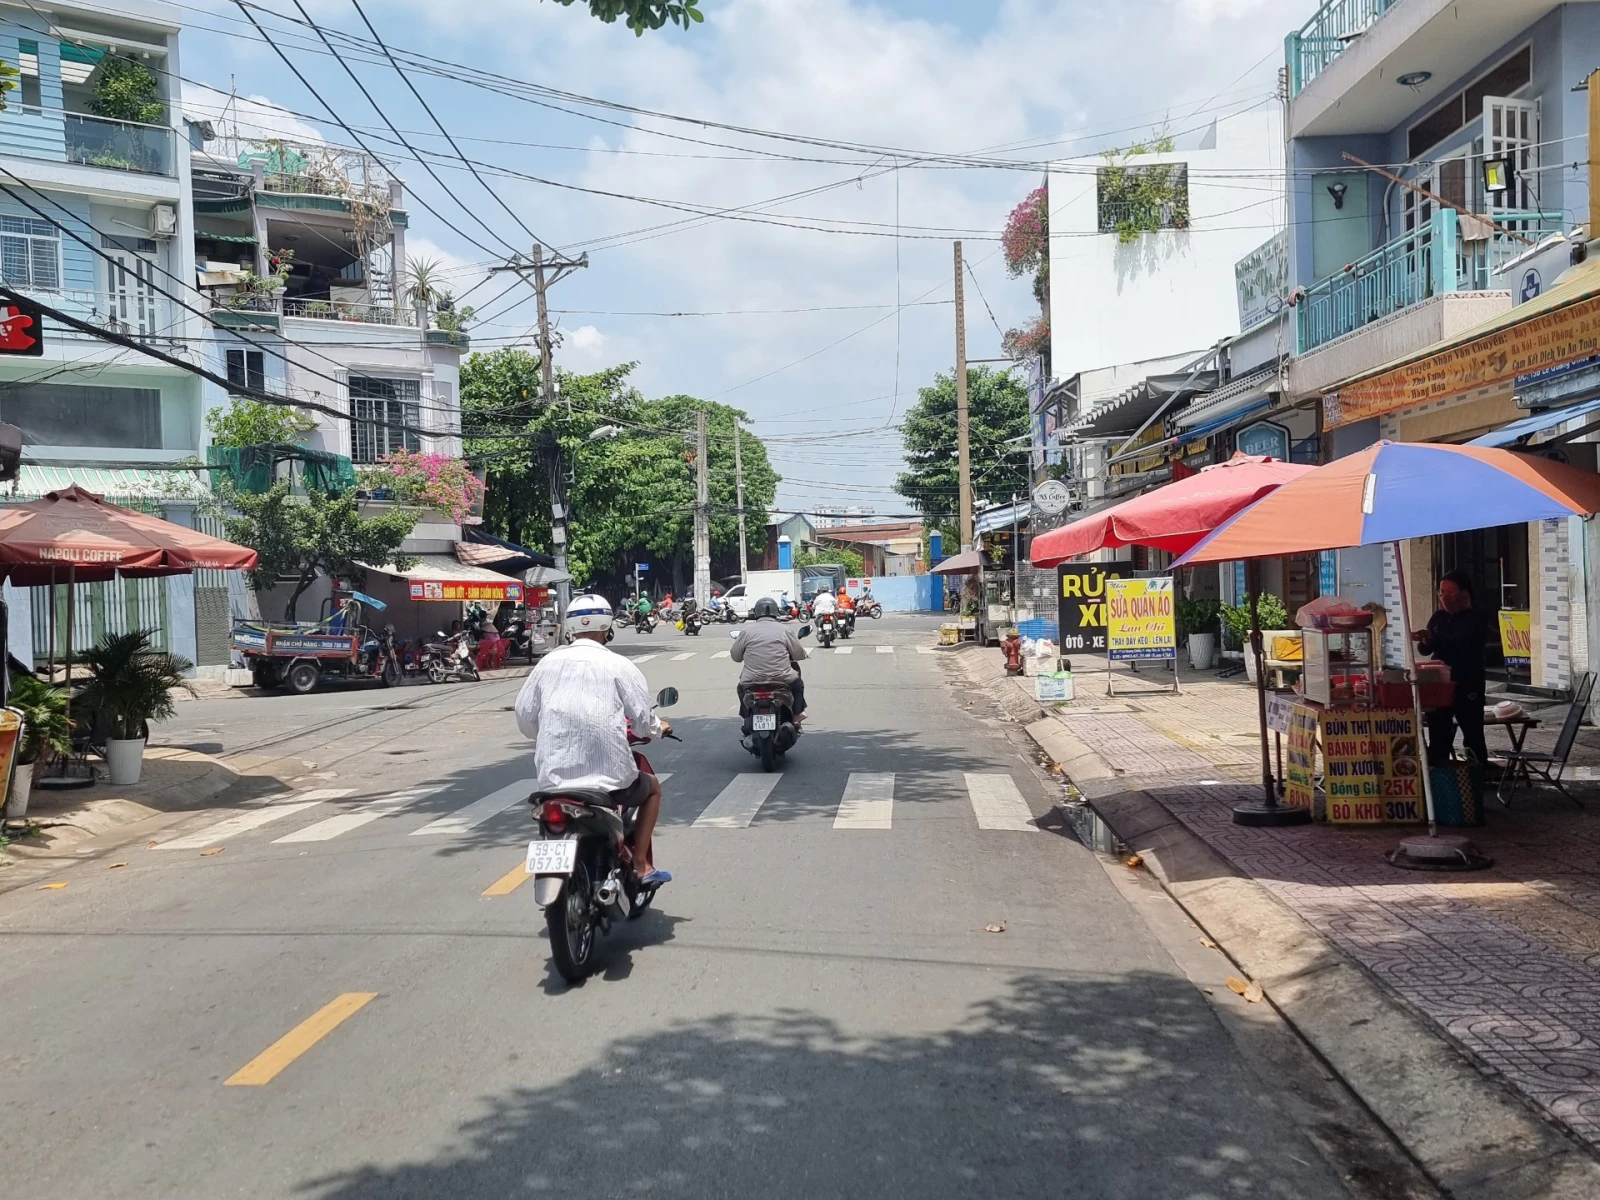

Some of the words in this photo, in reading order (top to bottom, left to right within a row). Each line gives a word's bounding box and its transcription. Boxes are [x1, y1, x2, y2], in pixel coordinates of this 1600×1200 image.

[1245, 436, 1280, 455] BEER
[39, 547, 80, 560] NAPOLI
[82, 549, 123, 562] COFFEE
[1325, 718, 1348, 736] BÚN
[1327, 739, 1357, 757] BÁNH
[1360, 741, 1387, 756] CANH
[1329, 761, 1348, 776] NUI
[1330, 781, 1360, 797] Đồng
[1383, 779, 1416, 796] 25K
[1332, 800, 1351, 820] BÒ
[1354, 803, 1383, 820] KHO
[1386, 801, 1418, 820] 30K
[535, 843, 567, 856] 59-C1
[529, 857, 569, 871] 057.34
